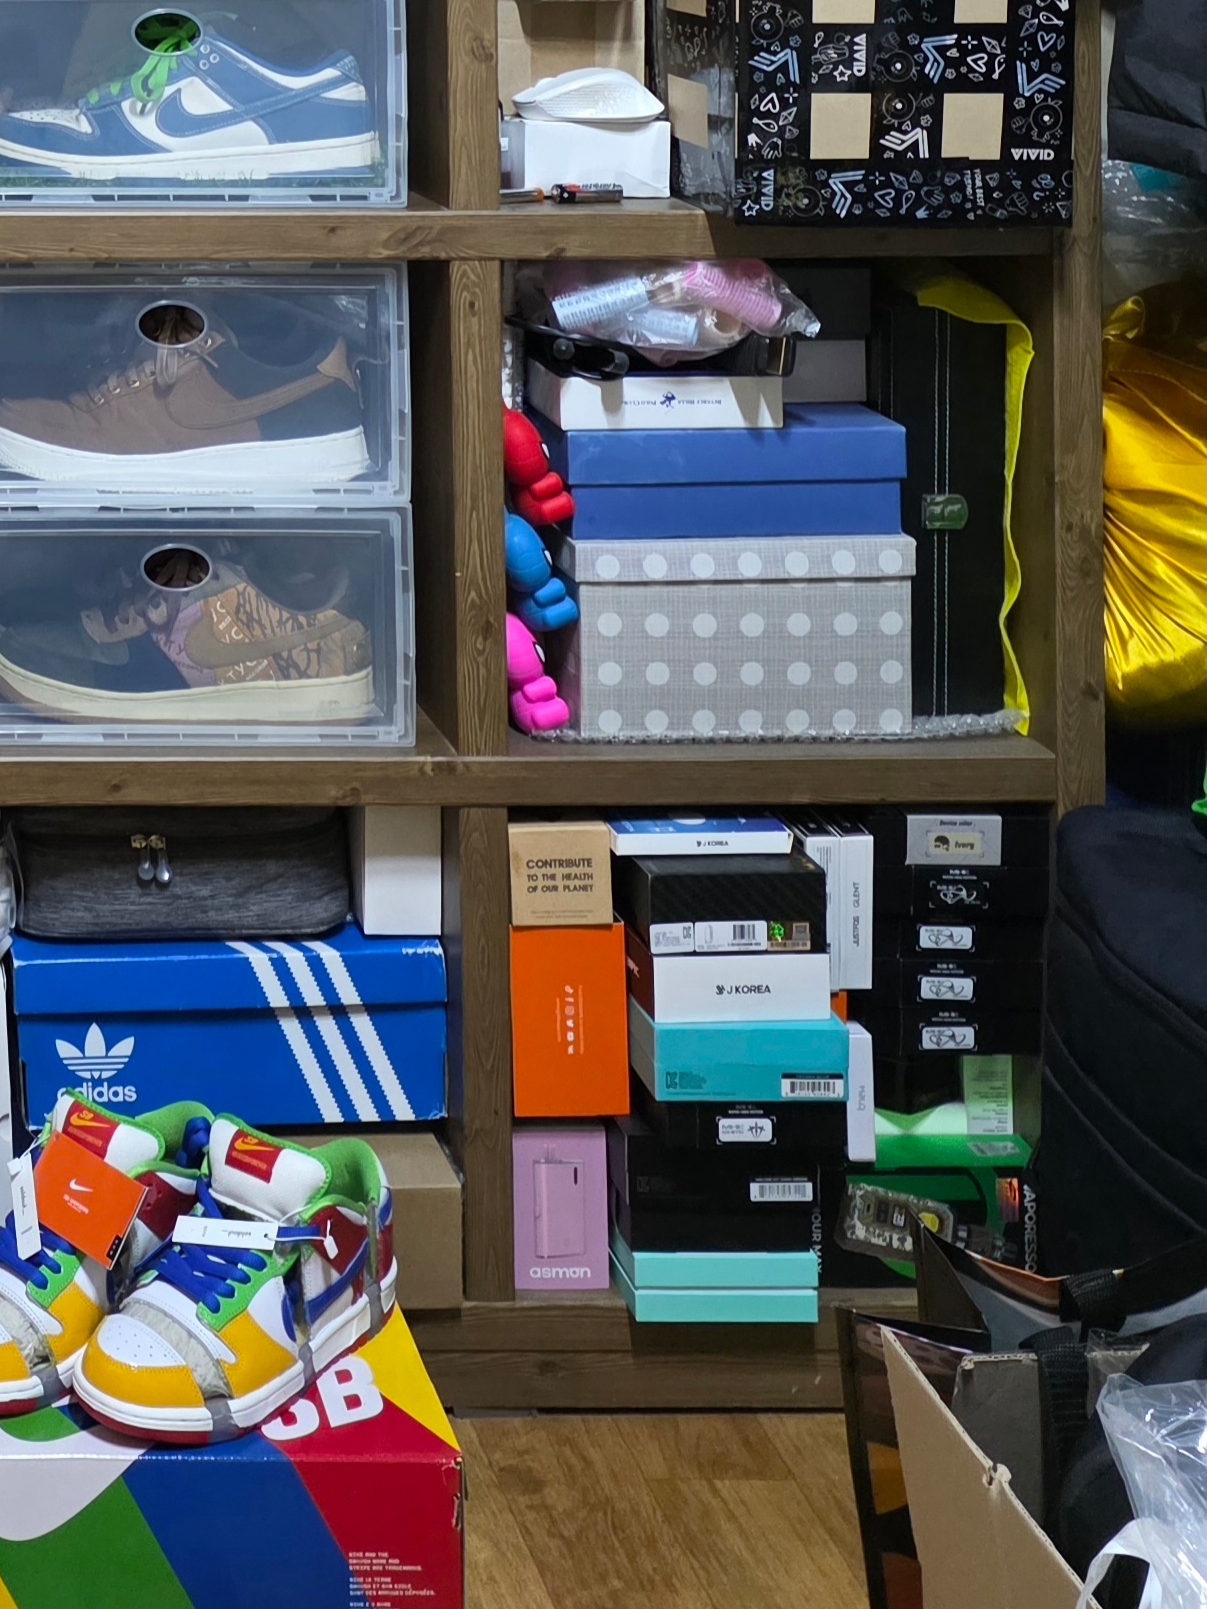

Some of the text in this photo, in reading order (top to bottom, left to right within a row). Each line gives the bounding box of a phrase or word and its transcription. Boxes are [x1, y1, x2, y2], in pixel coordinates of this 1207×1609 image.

[853, 33, 867, 77] VIVID
[1011, 148, 1054, 161] VIVID
[761, 168, 774, 211] VIVID
[526, 857, 593, 870] CONTRIBUTE
[527, 872, 594, 882] TO THE HEALTH
[527, 883, 594, 894] OF OUR PLANET
[726, 985, 771, 994] J KOREA
